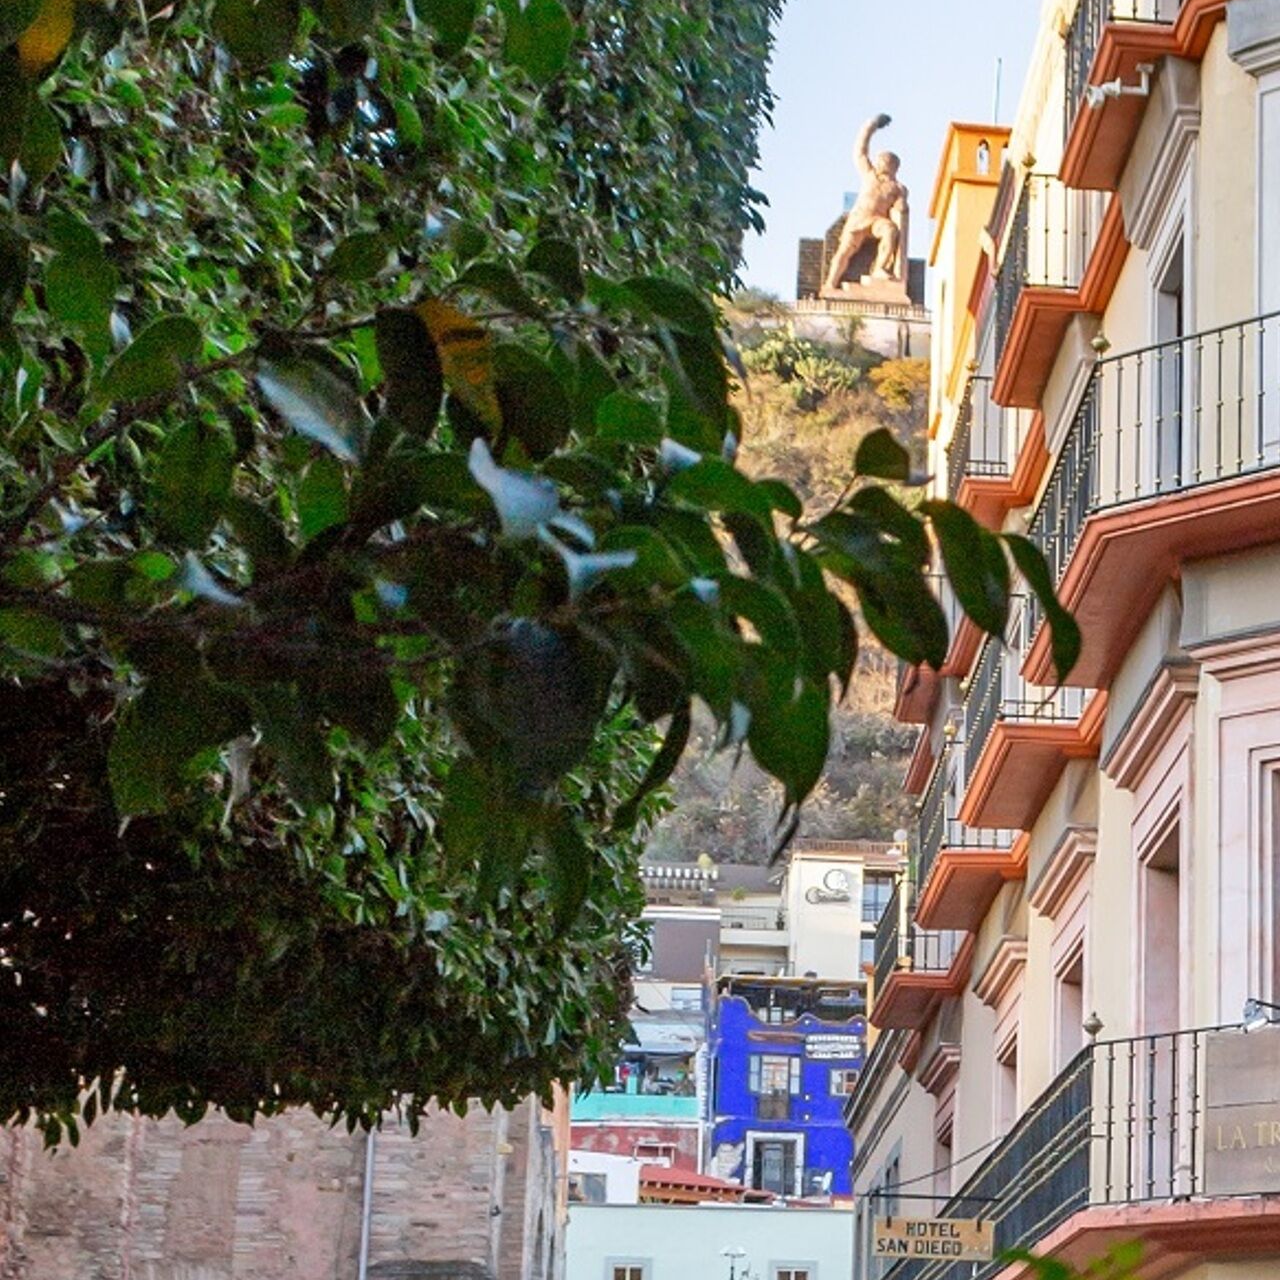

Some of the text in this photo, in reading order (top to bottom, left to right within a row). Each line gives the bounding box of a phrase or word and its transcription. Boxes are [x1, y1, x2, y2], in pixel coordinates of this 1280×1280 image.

[1216, 1124, 1247, 1151] LA
[906, 1222, 960, 1238] HOTEL
[877, 1238, 962, 1256] SAN DIEGO
